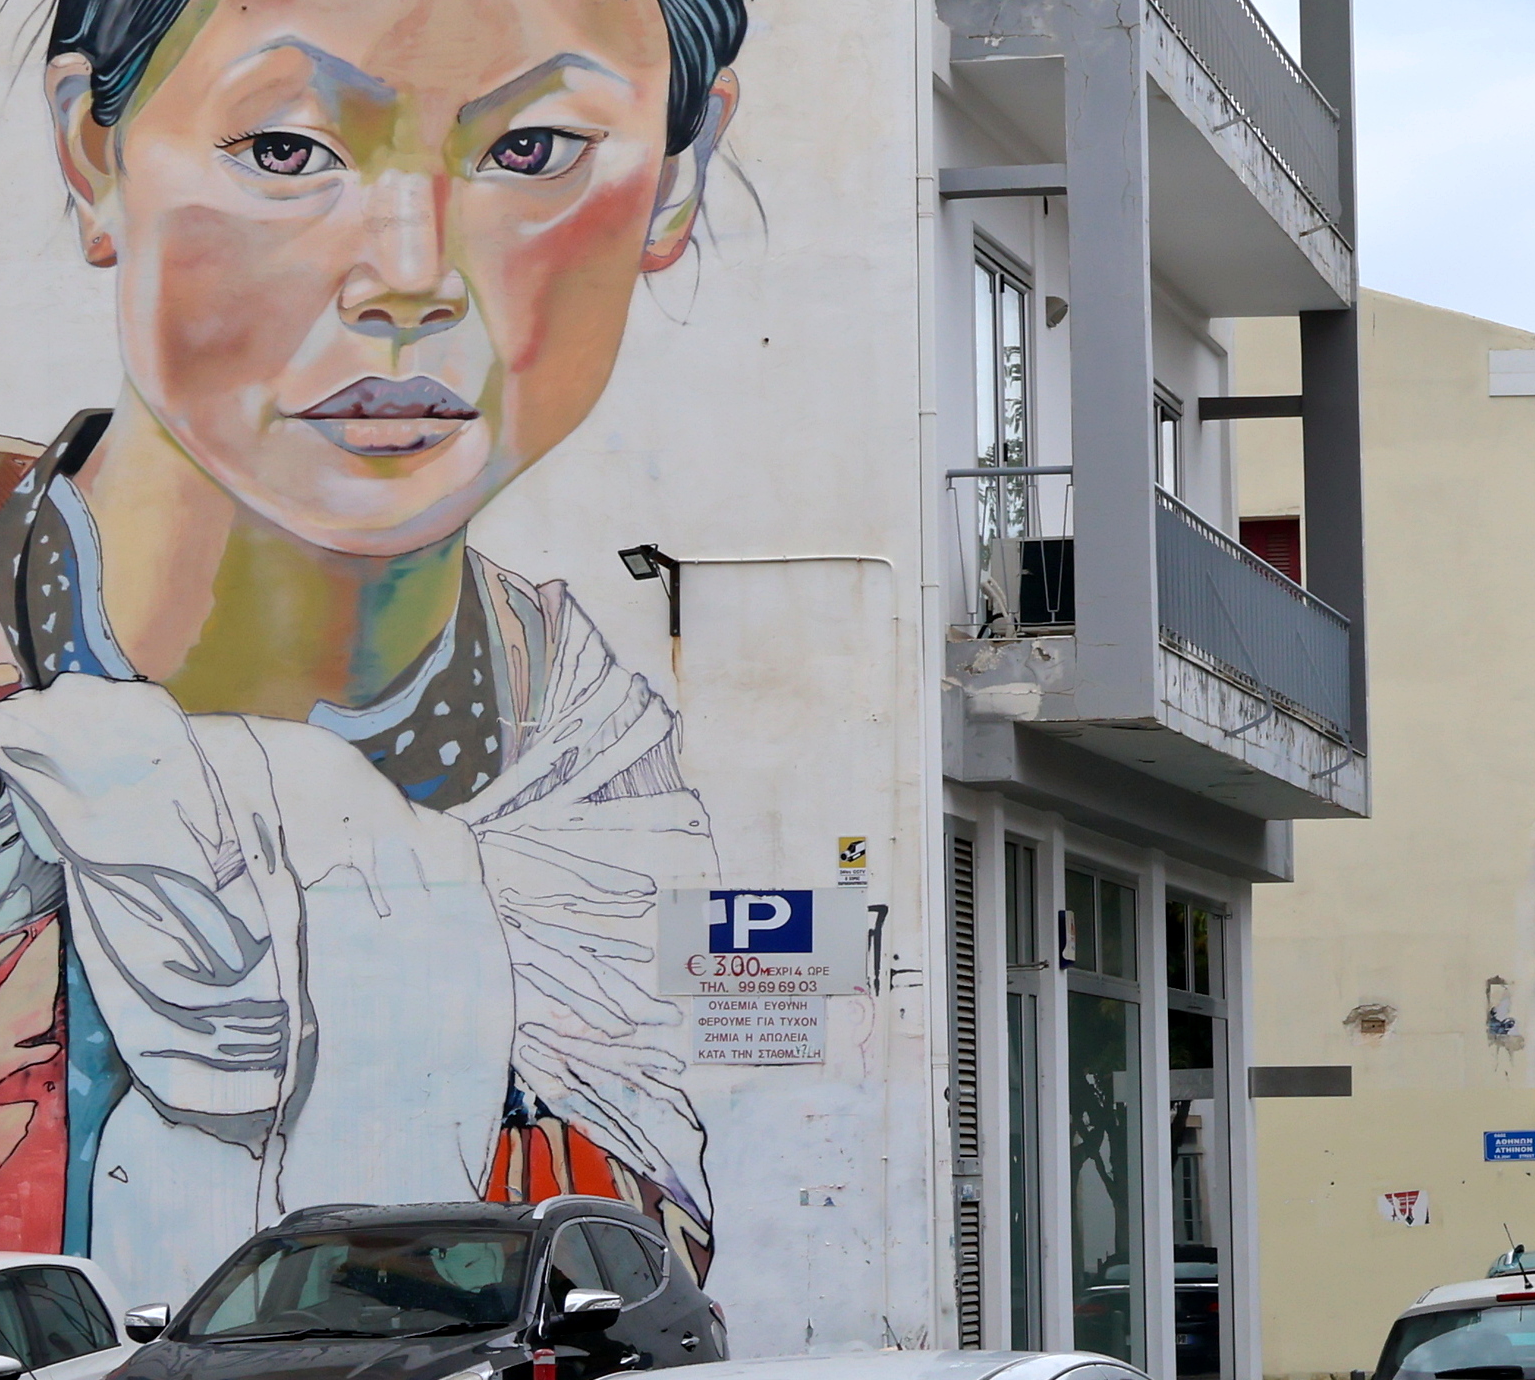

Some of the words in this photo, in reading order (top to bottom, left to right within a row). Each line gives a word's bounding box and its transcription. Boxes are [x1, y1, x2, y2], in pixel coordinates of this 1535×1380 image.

[699, 982, 729, 993] ΤΗΛ.
[708, 1001, 758, 1010] ΟΥΔΕΜΙΑ
[765, 1001, 808, 1010] ΕΥΘΥΝΗ
[698, 1017, 751, 1027] ΦΕΡΟΥΜΕ
[756, 1017, 775, 1026] ΓΙΑ
[780, 1017, 818, 1026] ΤΥΧΟΝ
[704, 1033, 740, 1042] ΖΗΜΙΑ
[745, 1033, 753, 1042] Η
[759, 1033, 808, 1042] ΑΠΩΛΕΙΑ
[698, 1050, 726, 1059] ΚΑΤΑ
[731, 1050, 752, 1059] ΤΗΝ
